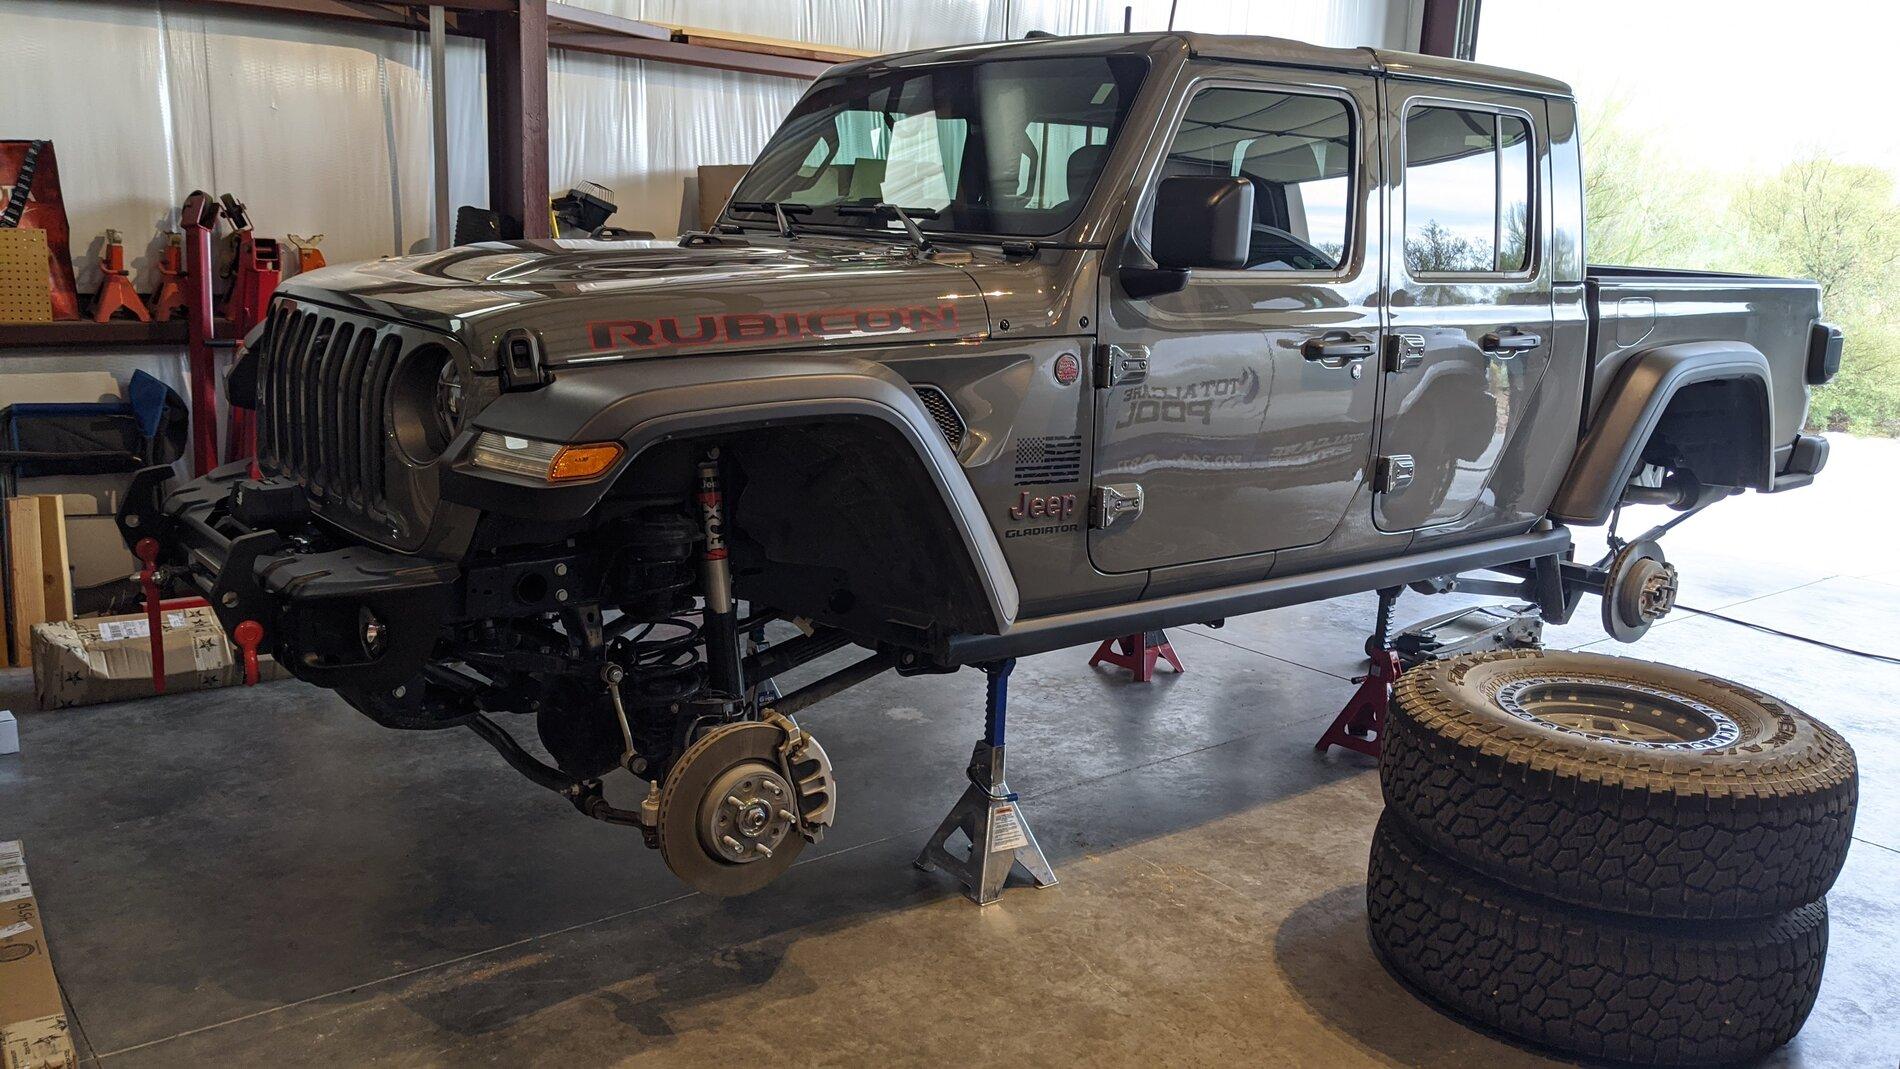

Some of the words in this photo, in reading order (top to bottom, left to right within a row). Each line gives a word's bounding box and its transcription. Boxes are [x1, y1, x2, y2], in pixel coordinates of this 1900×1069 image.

[588, 304, 960, 351] RUBICON
[1010, 491, 1077, 522] Jeep
[703, 502, 725, 551] FOX
[1005, 524, 1079, 538] GLADIATOR
